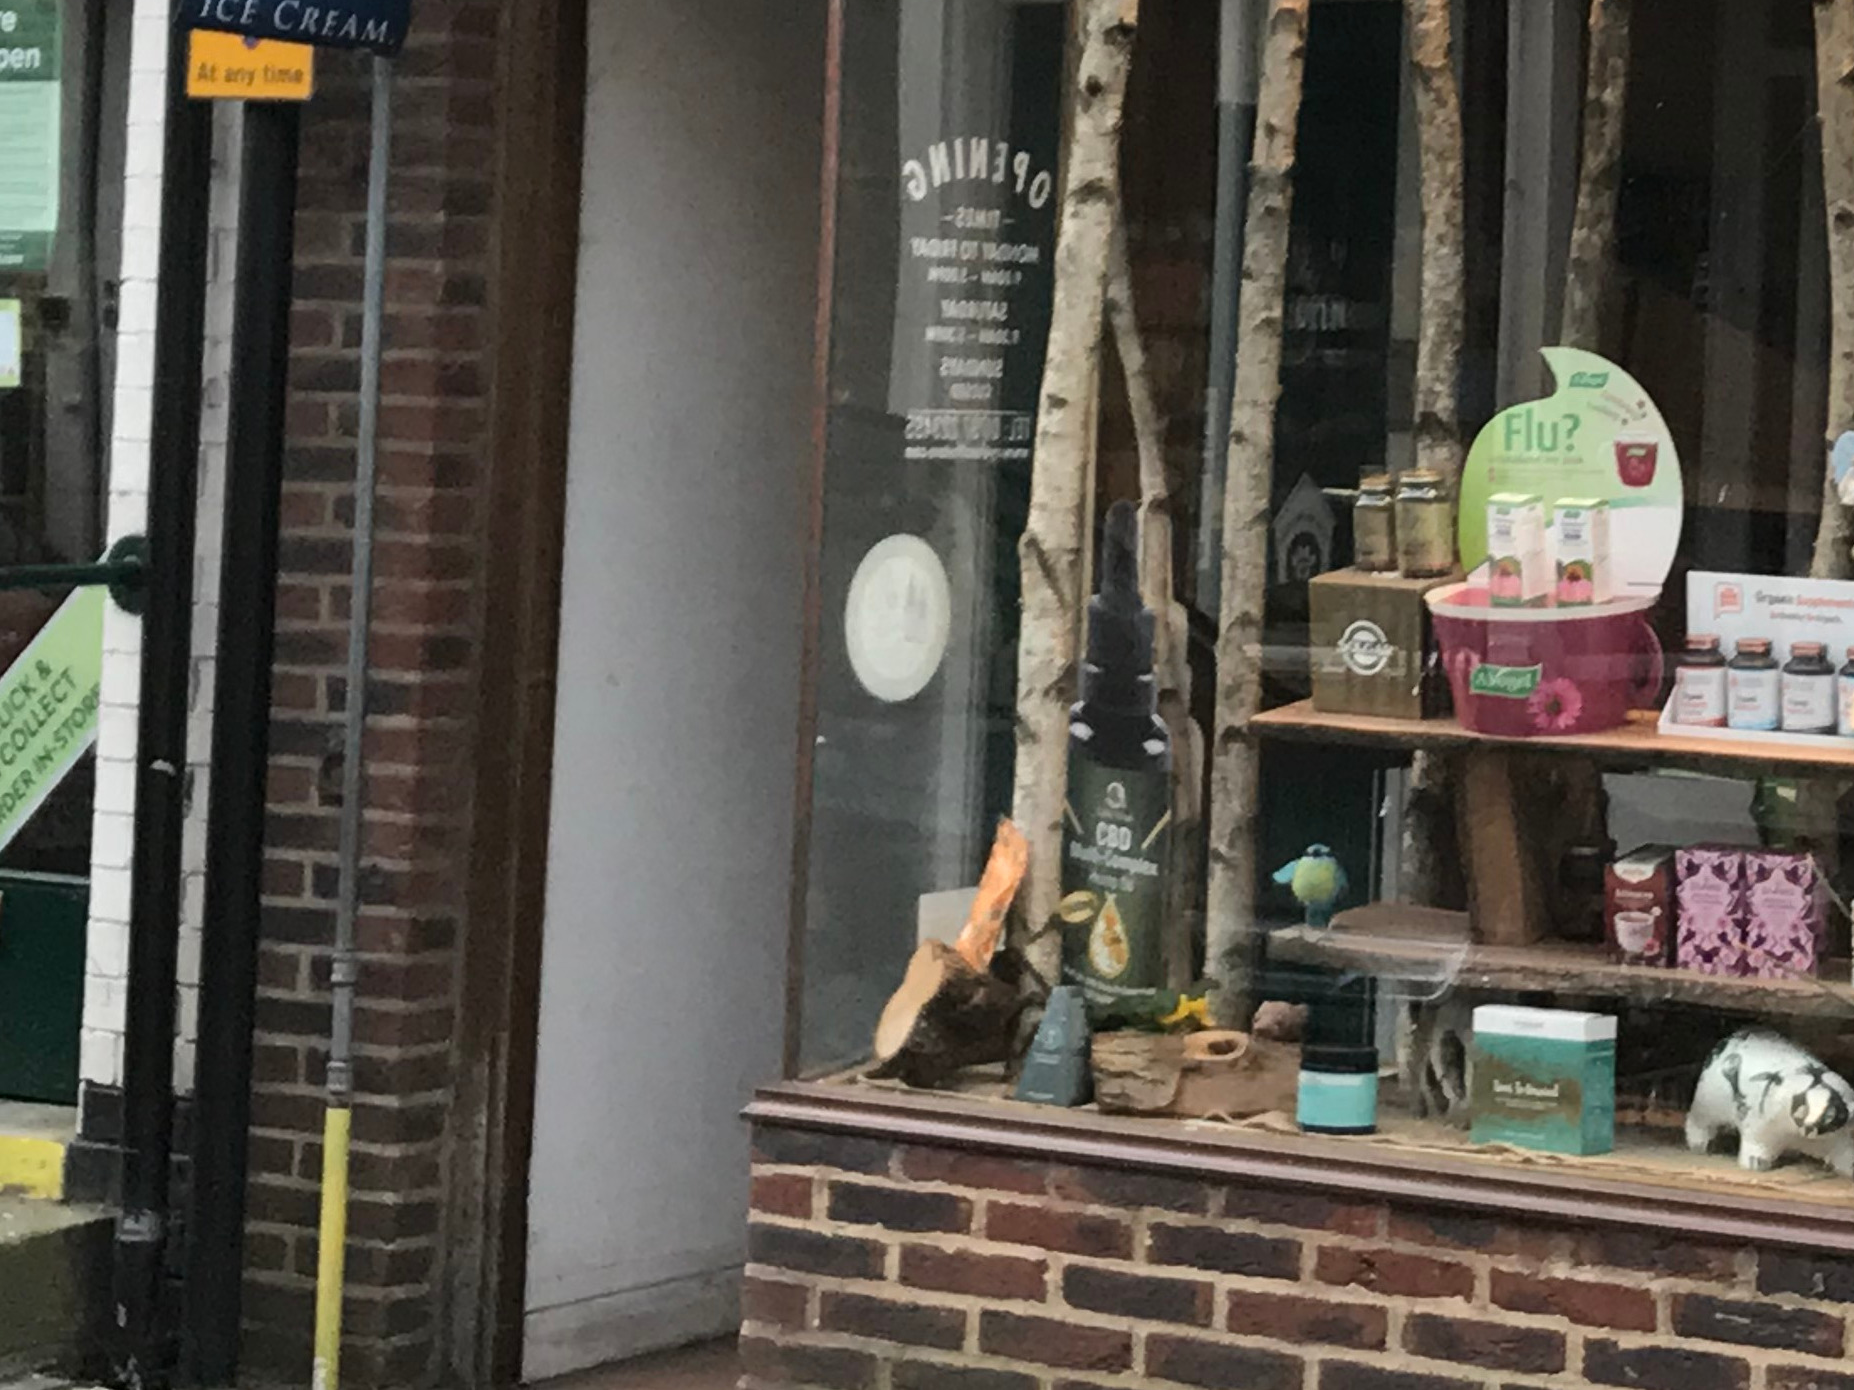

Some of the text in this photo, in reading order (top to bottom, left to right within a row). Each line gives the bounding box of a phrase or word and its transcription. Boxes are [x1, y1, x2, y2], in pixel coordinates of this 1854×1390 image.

[197, 63, 304, 87] At any time
[1503, 407, 1582, 453] Flu?
[0, 666, 77, 766] COLLECT
